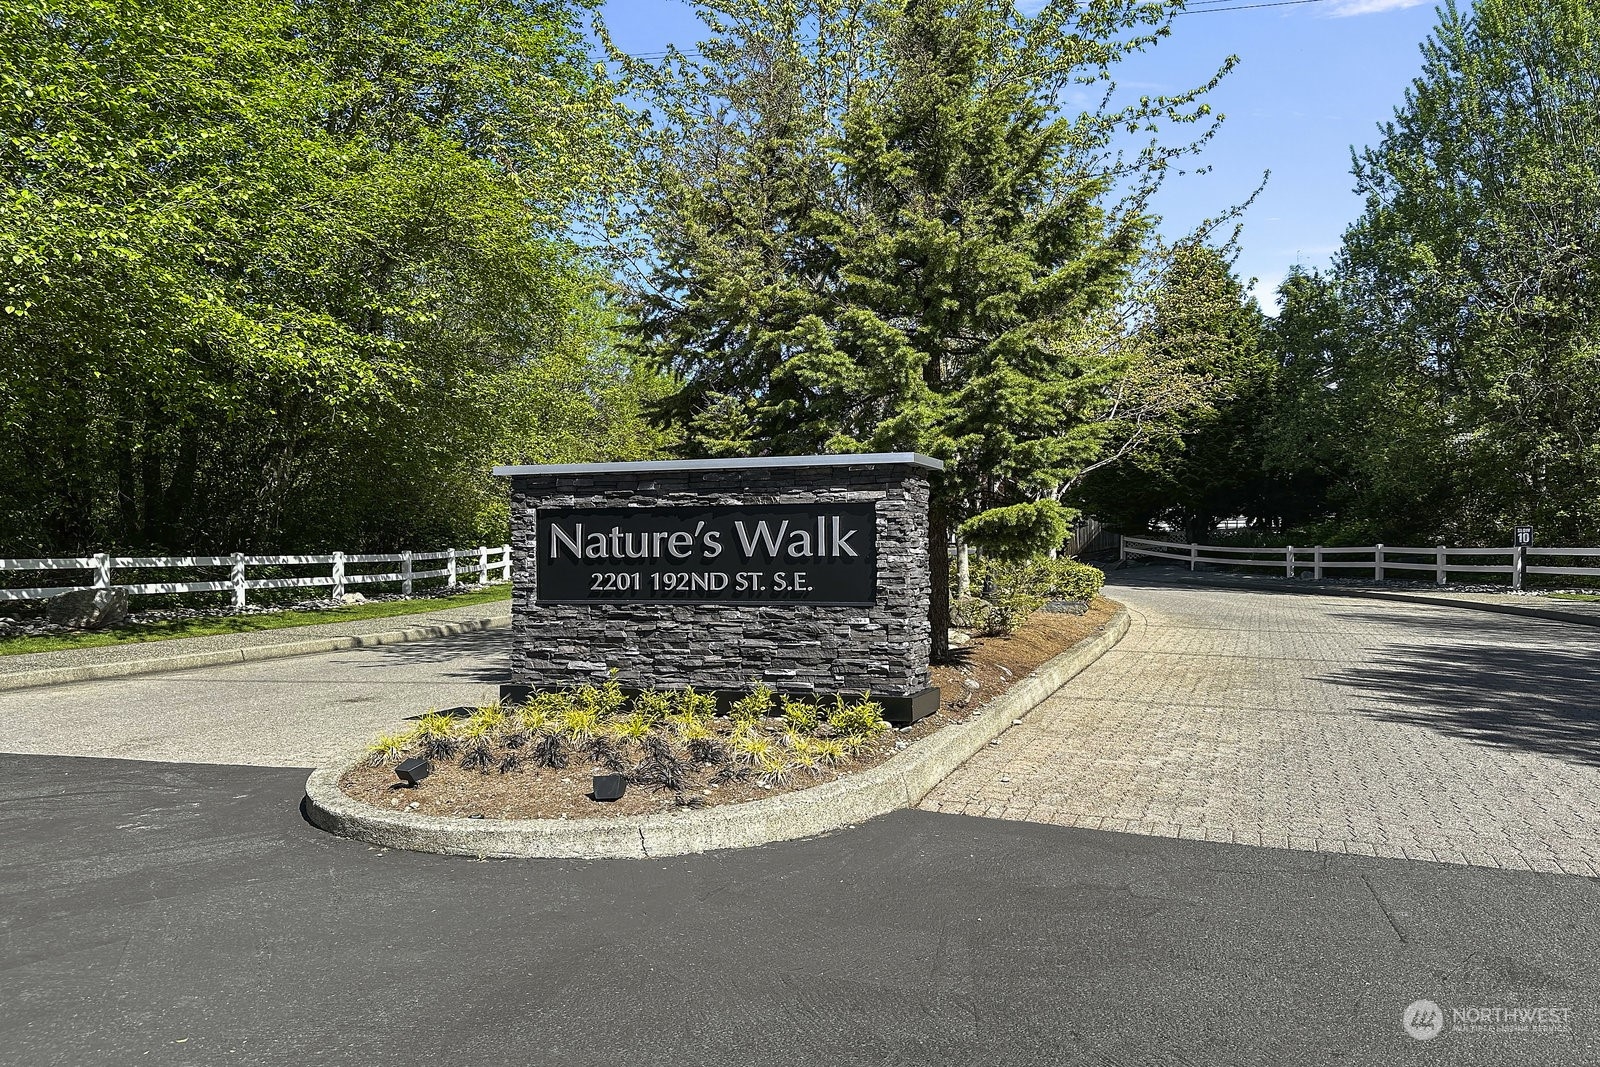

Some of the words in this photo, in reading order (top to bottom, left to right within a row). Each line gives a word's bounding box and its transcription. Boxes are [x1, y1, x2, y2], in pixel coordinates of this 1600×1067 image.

[550, 520, 724, 559] Nature's
[734, 515, 859, 558] Walk
[1517, 532, 1530, 543] 10
[590, 572, 641, 591] 2201
[650, 572, 729, 591] 192ND
[735, 572, 766, 591] ST.
[773, 572, 814, 592] S.E.
